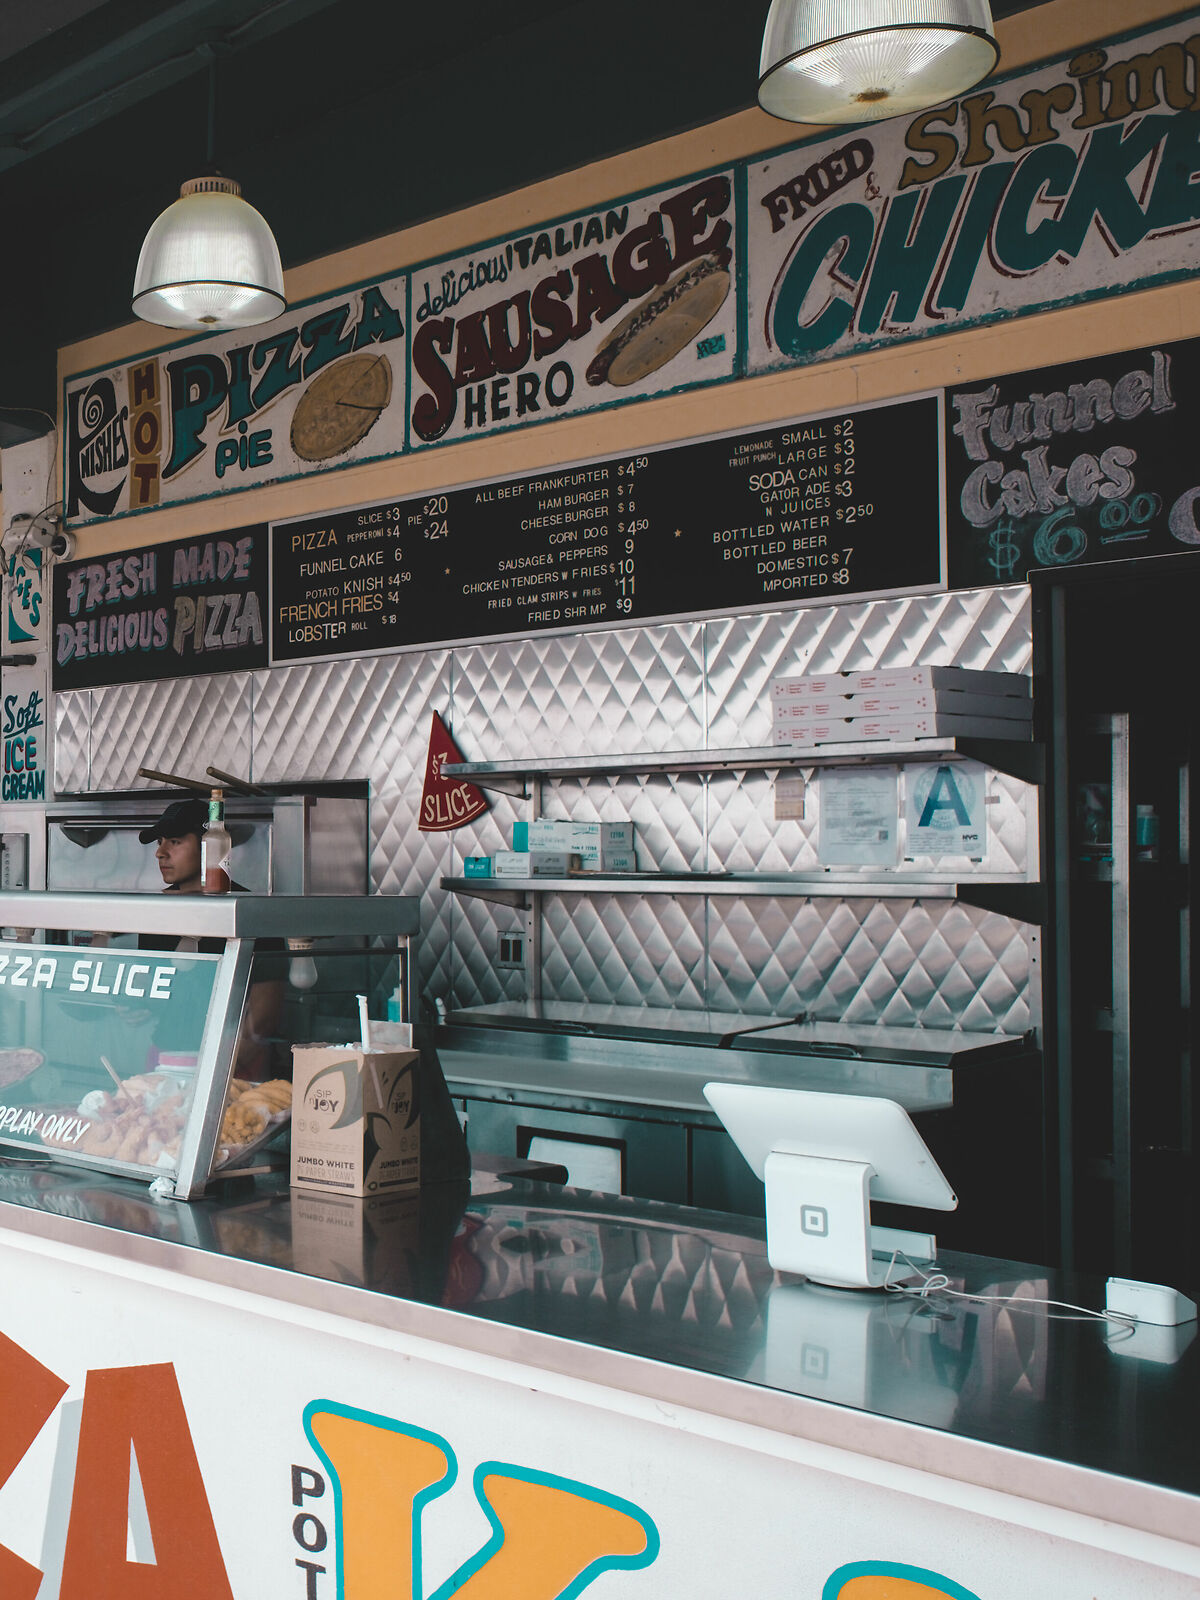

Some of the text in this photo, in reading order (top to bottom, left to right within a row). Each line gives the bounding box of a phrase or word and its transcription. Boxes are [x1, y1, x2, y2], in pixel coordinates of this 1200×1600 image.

[761, 138, 874, 233] FRIED
[416, 205, 629, 322] delicious ITALIAN
[412, 176, 733, 442] SAUSAGE
[161, 286, 405, 480] PIZZA
[464, 361, 574, 430] HERO
[953, 350, 1176, 461] Funnel
[134, 362, 159, 503] HOT
[734, 419, 854, 455] LEMONADE SMALL $2
[729, 438, 855, 468] FRUIT PUNCH LARGE $3
[475, 491, 495, 503] ALL
[497, 485, 525, 500] BEEF
[528, 469, 609, 493] FRANKFURTER
[749, 458, 855, 492] SODA CAN $2
[835, 480, 853, 497] $3
[961, 445, 1137, 528] Cakes
[357, 507, 400, 525] SLICE $3
[407, 496, 448, 526] PIE $20
[781, 497, 831, 515] JUICES
[292, 520, 449, 552] PIZZA PEPPERONI $4 $24
[549, 531, 578, 545] CORN
[584, 526, 608, 540] DOG
[713, 525, 775, 543] BOTTLED
[781, 515, 830, 533] WATER
[300, 548, 402, 576] FUNNEL CAKE 6
[559, 545, 608, 562] PEPPERS
[625, 539, 634, 554] 9
[723, 535, 827, 561] BOTTLED BEER
[757, 548, 853, 574] DOMESTIC $7
[67, 536, 254, 617] FRESH MADE
[305, 586, 339, 600] POTATO
[343, 576, 384, 594] KNISH
[463, 578, 509, 595] CHICKEN
[511, 572, 559, 588] TENDERS
[572, 565, 608, 579] FRIES
[609, 558, 635, 575] $10
[832, 568, 850, 585] $8
[280, 591, 400, 624] FRENCH FRIES $4
[488, 598, 512, 610] FRIED
[517, 595, 538, 606] CLAM
[541, 590, 569, 602] STRIPS
[582, 588, 602, 597] FRIES
[528, 610, 560, 623] FRIED
[616, 598, 633, 614] $9
[56, 591, 264, 667] DELICIOUS PIZZA
[289, 621, 347, 643] LOBSTER
[351, 621, 368, 631] ROLL
[3, 690, 43, 733] Soft
[4, 735, 38, 773] ICE
[2, 769, 45, 801] CREAM
[918, 766, 972, 827] A
[424, 783, 479, 823] SLICE
[69, 960, 177, 1000] SLICE
[316, 1089, 332, 1098] SIP
[41, 1114, 91, 1145] ONLY
[297, 1156, 355, 1170] JUMBO WHITE
